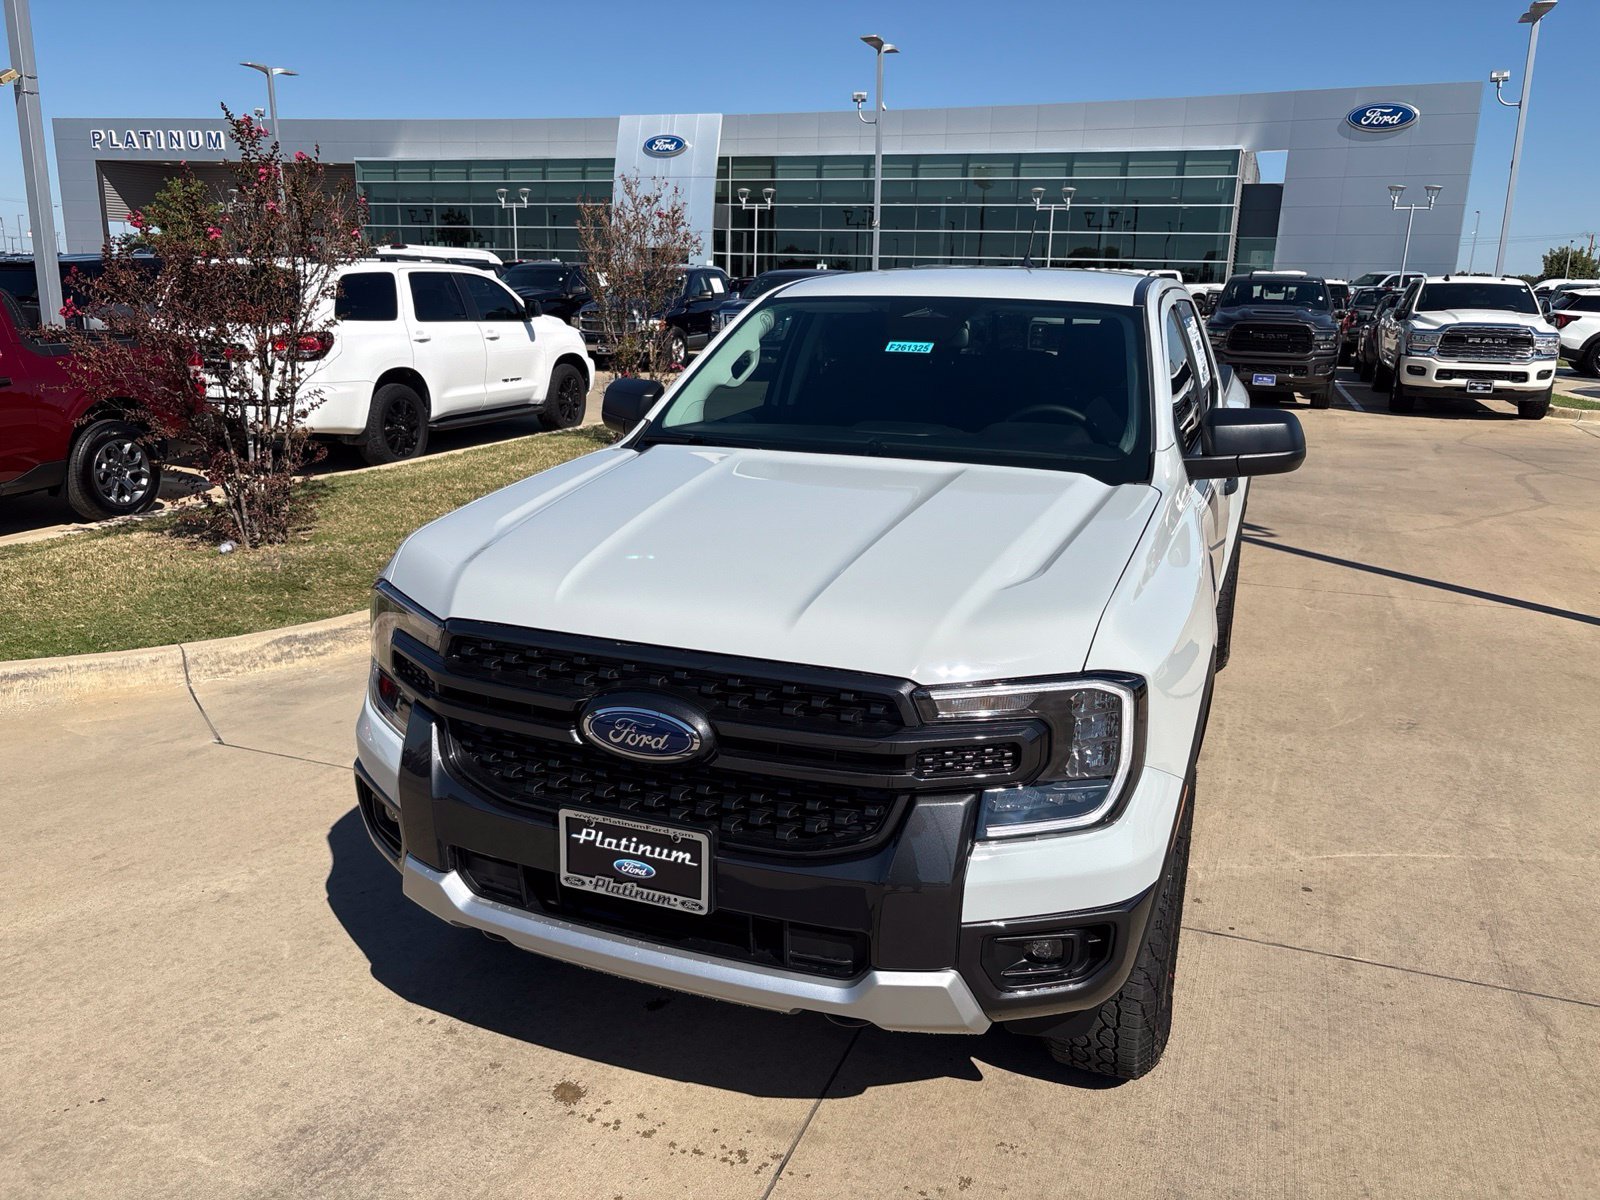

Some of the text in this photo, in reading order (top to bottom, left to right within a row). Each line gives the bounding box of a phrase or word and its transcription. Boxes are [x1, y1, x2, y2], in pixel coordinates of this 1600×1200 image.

[1361, 108, 1403, 125] Ford
[90, 129, 226, 150] PLATINUM
[652, 138, 678, 151] Ford
[888, 343, 932, 352] F261325
[608, 717, 671, 751] Ford
[573, 811, 695, 839] www.PlatinumFord.com
[571, 827, 699, 867] Platinum
[620, 860, 649, 877] Ford
[593, 876, 677, 906] Platinum
